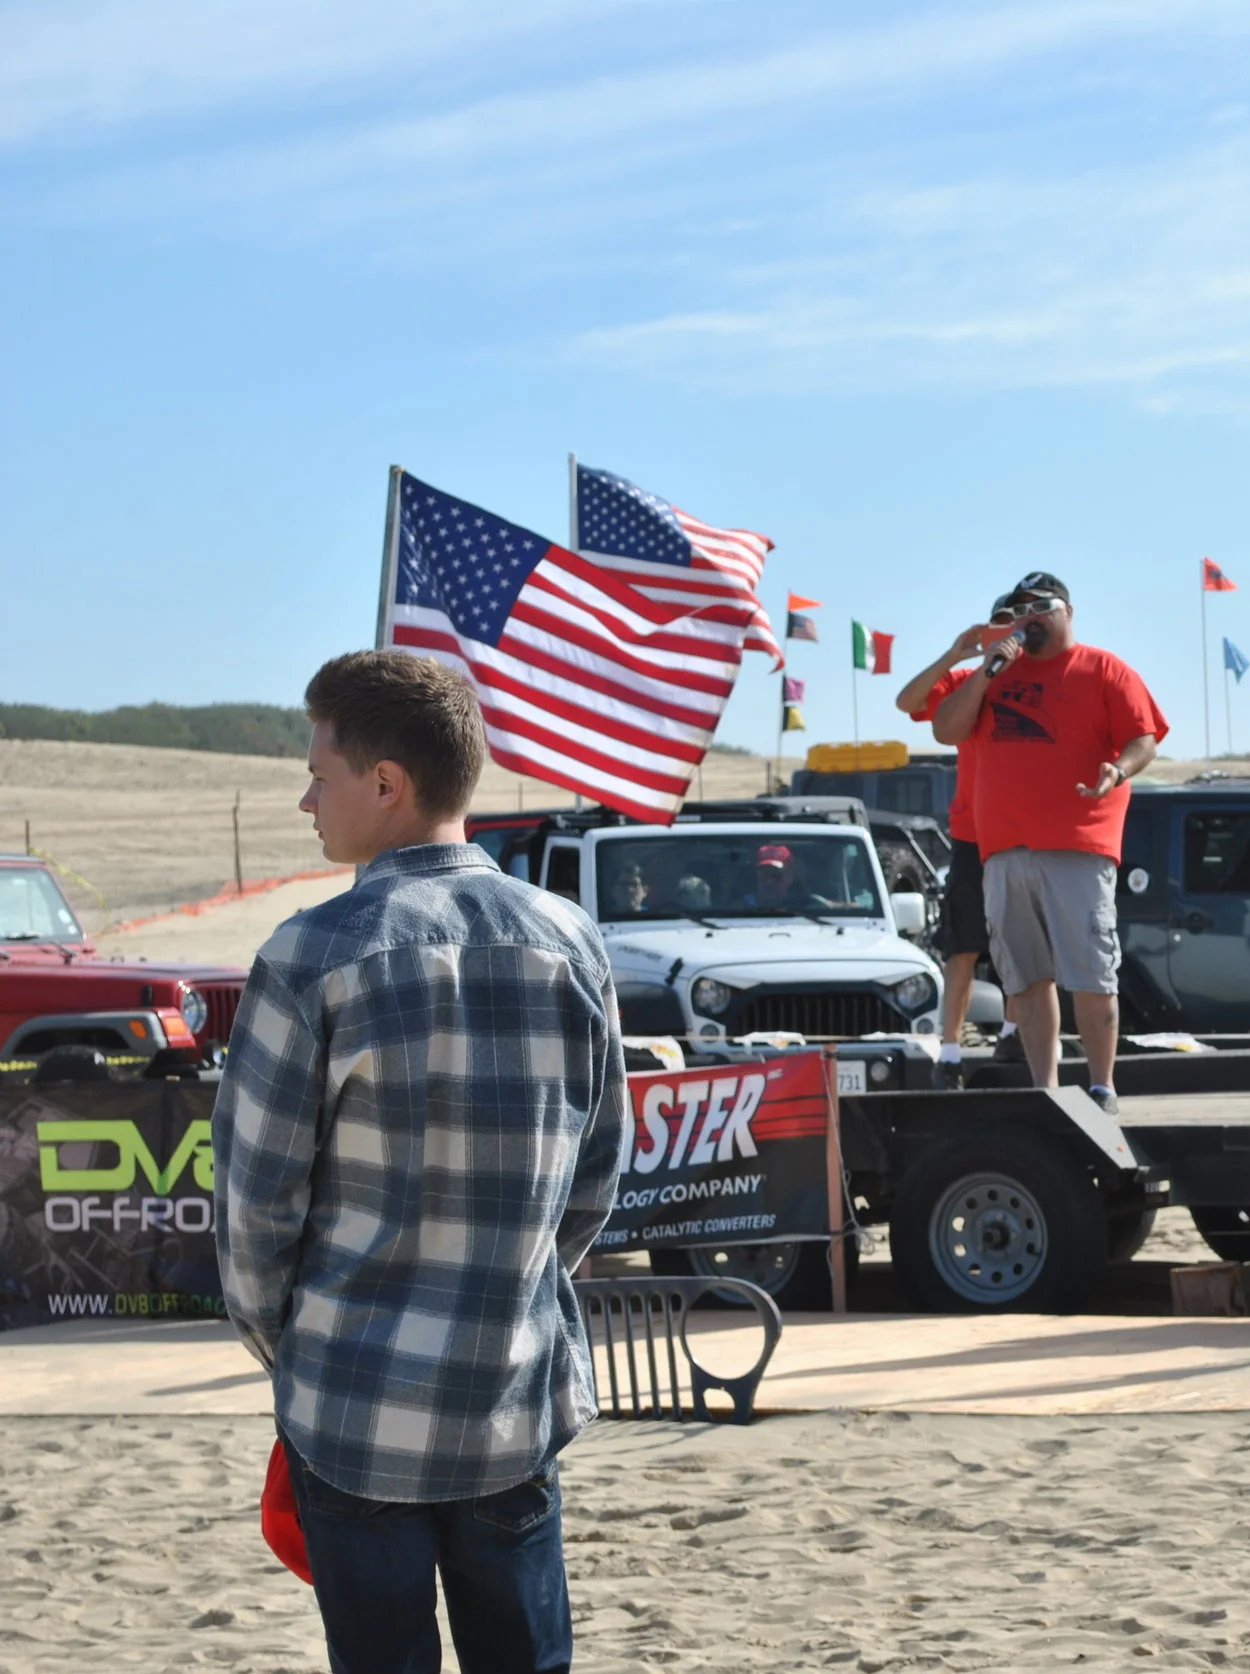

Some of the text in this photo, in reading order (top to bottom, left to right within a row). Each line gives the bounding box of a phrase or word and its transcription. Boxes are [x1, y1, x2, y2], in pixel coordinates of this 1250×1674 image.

[658, 1174, 763, 1205] COMPANY
[44, 1195, 216, 1234] OFFRO
[642, 1219, 702, 1241] CATALYTIC
[703, 1213, 776, 1234] CONVERTERS
